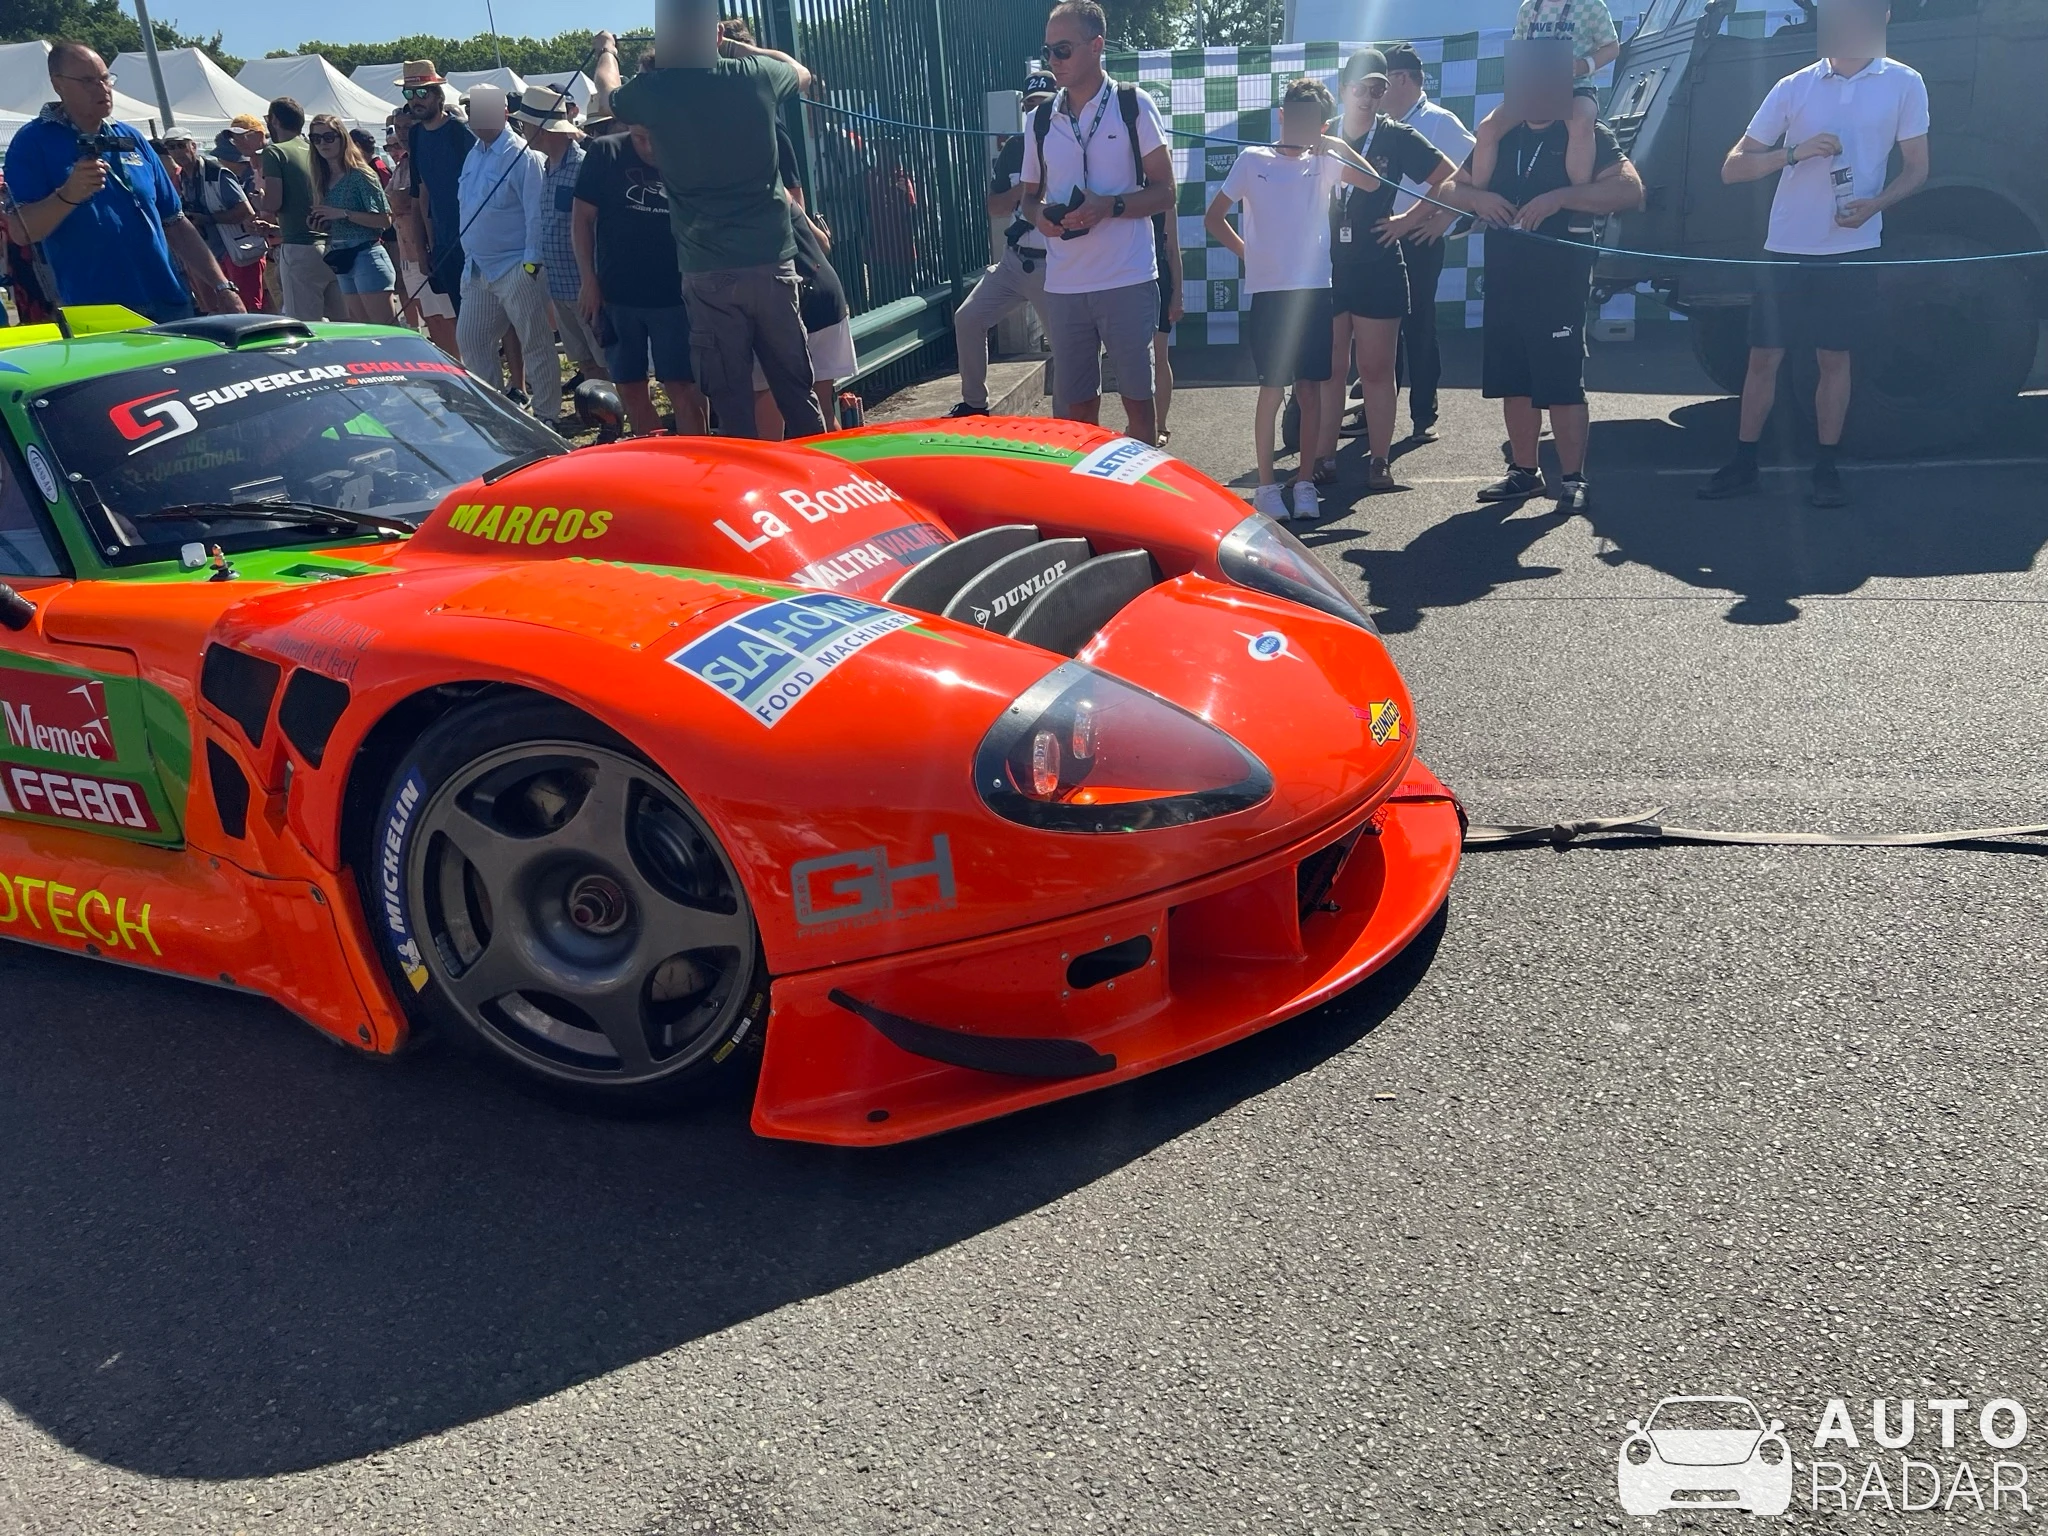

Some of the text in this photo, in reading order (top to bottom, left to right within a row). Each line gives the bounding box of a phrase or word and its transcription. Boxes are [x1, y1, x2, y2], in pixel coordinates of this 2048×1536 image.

[189, 364, 352, 411] SUPERCAR
[286, 385, 330, 398] POWERED
[448, 504, 614, 545] MARCOS
[712, 474, 904, 553] La Bomba
[791, 542, 894, 590] VALTRA
[991, 560, 1067, 617] DUNLOP
[701, 599, 881, 695] SLAHOMA
[755, 614, 916, 723] FOOD MACHINERY
[2, 701, 101, 760] Memec
[1371, 700, 1400, 742] SUNOCO
[10, 768, 148, 828] FEBO
[383, 778, 420, 934] MICHELIN
[790, 833, 957, 926] GH
